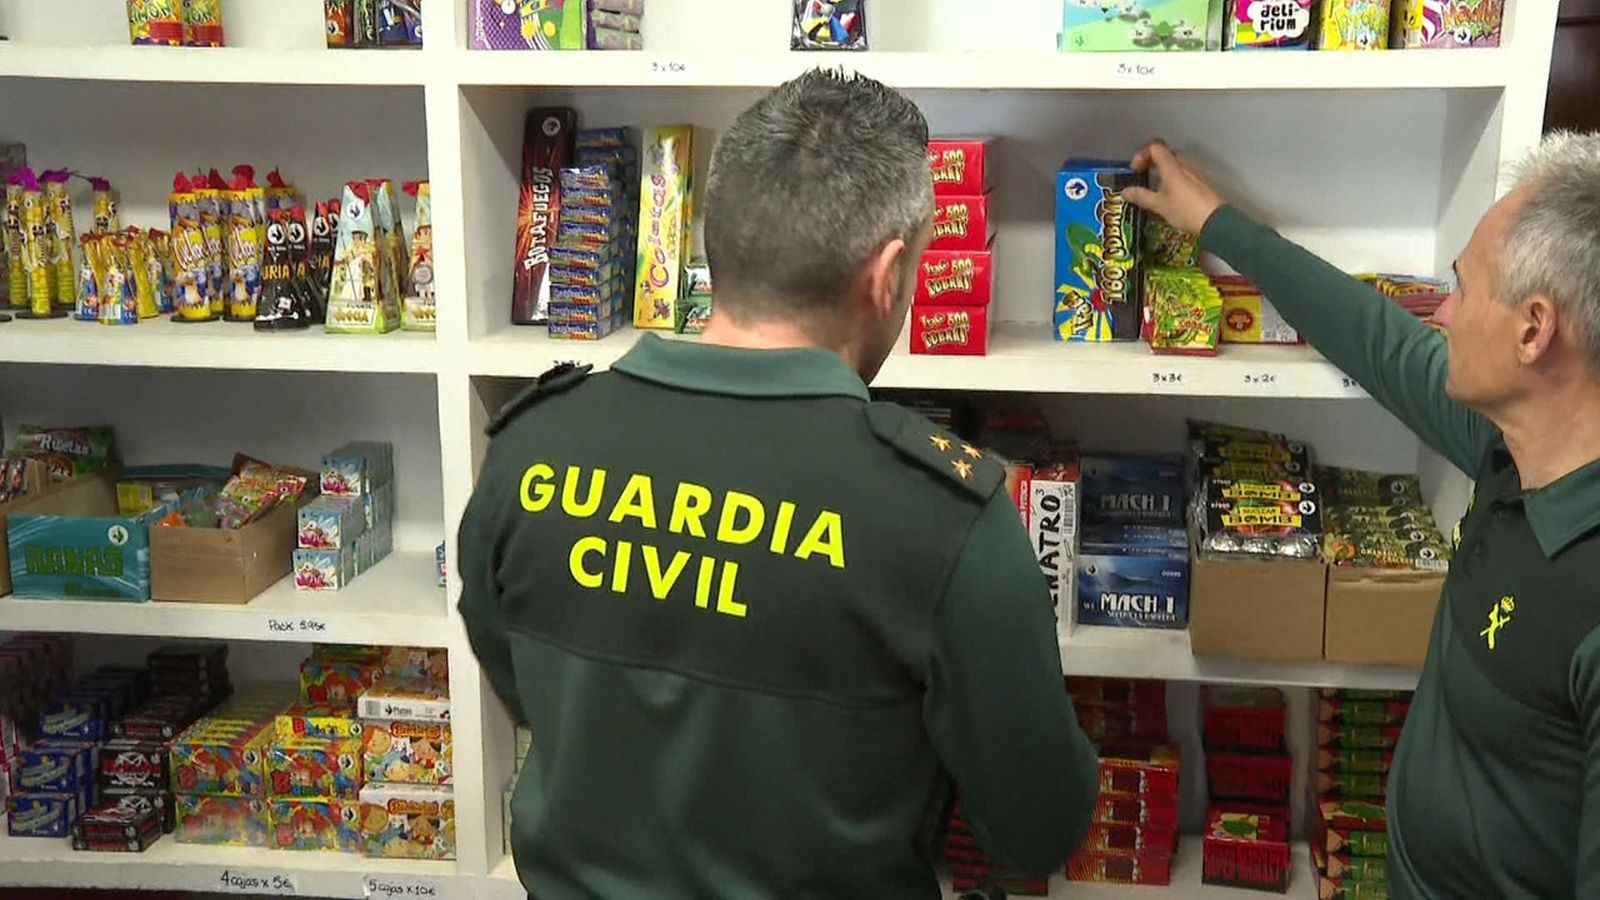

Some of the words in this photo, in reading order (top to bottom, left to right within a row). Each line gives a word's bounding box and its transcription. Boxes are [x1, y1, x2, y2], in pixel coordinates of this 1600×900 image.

[1261, 3, 1300, 18] deli-
[1260, 18, 1296, 31] rium
[943, 149, 964, 163] 500
[946, 203, 968, 217] 500
[523, 166, 553, 270] BOTAFUEGOS
[951, 258, 972, 272] 500
[1100, 266, 1128, 304] 160
[947, 311, 968, 325] 500
[1101, 494, 1154, 511] MACH
[519, 463, 845, 569] GUARDIA
[569, 535, 748, 617] CIVIL
[1101, 593, 1158, 613] MACH
[1166, 596, 1175, 614] 1
[268, 619, 294, 631] Pack
[261, 877, 269, 887] x
[272, 874, 291, 889] 5€
